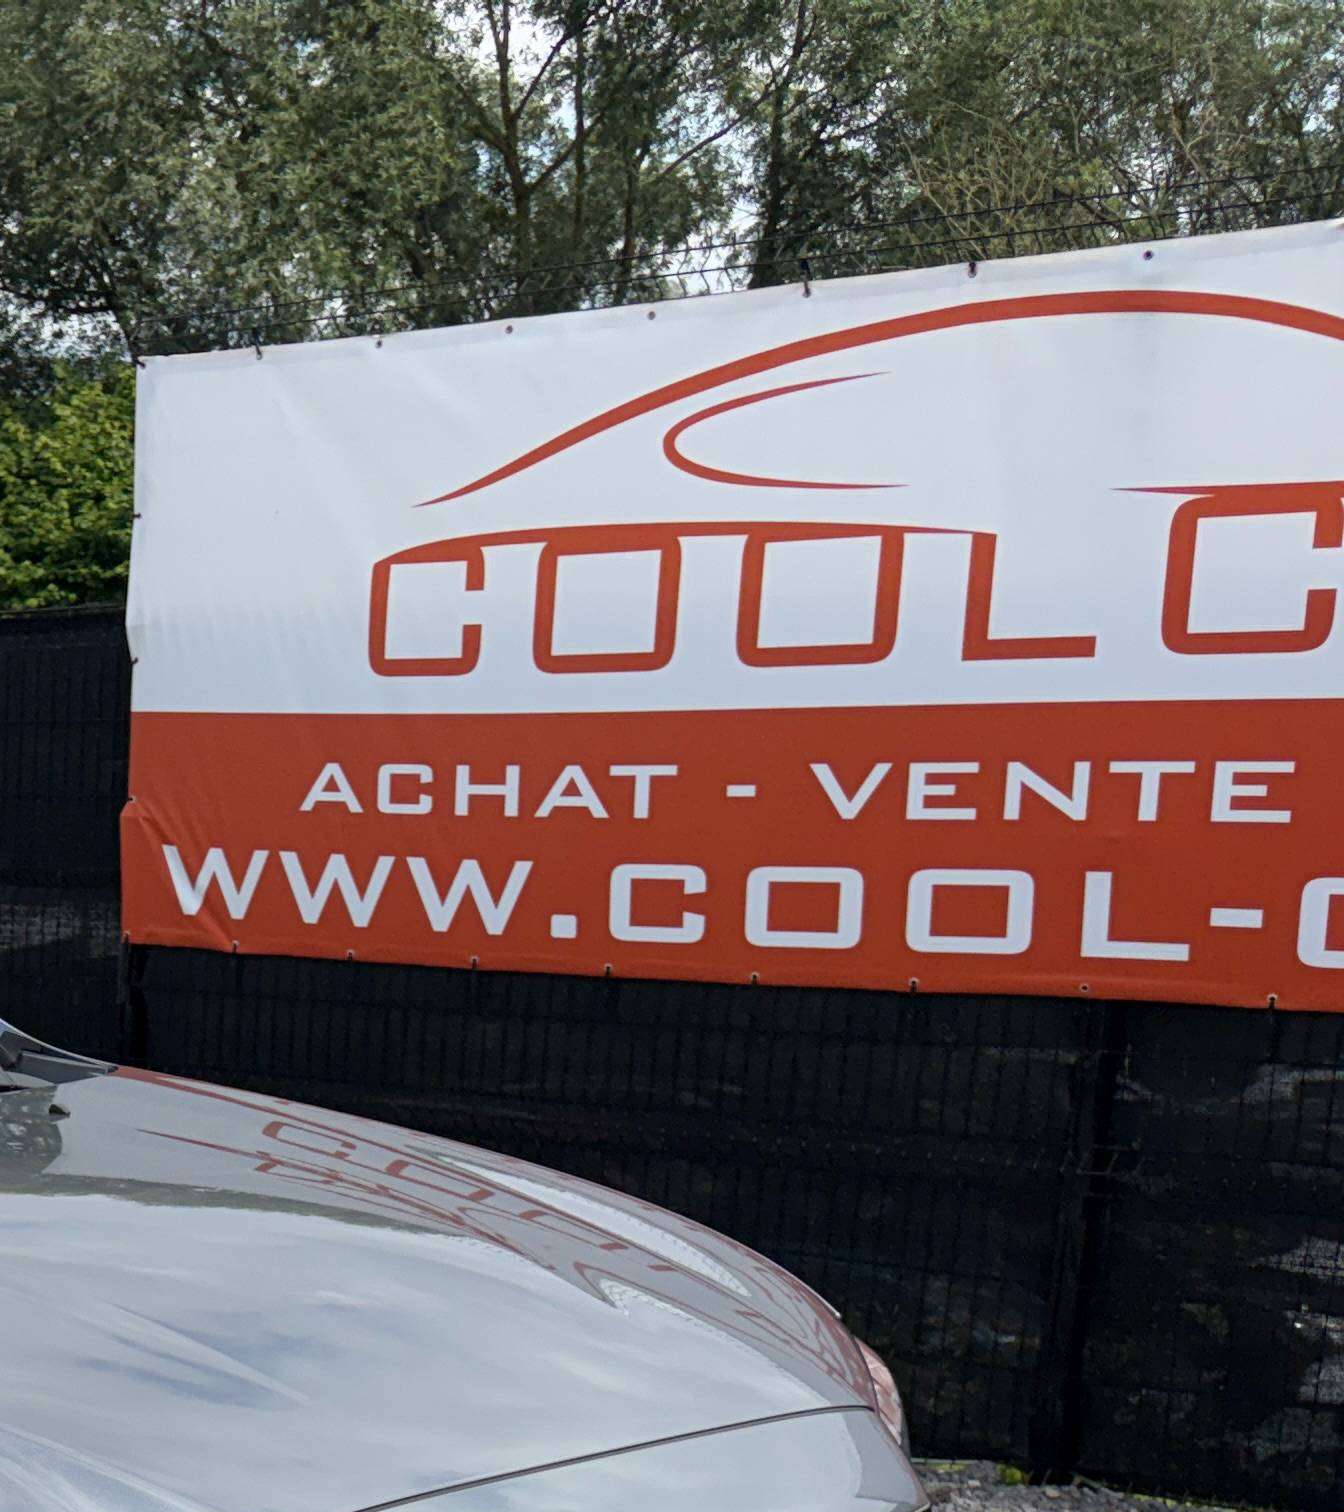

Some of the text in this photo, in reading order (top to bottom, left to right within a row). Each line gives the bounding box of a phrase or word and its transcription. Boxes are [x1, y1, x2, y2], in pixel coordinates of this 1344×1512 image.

[369, 521, 1096, 676] COOL
[300, 760, 1296, 824] ACHAT - VENTE
